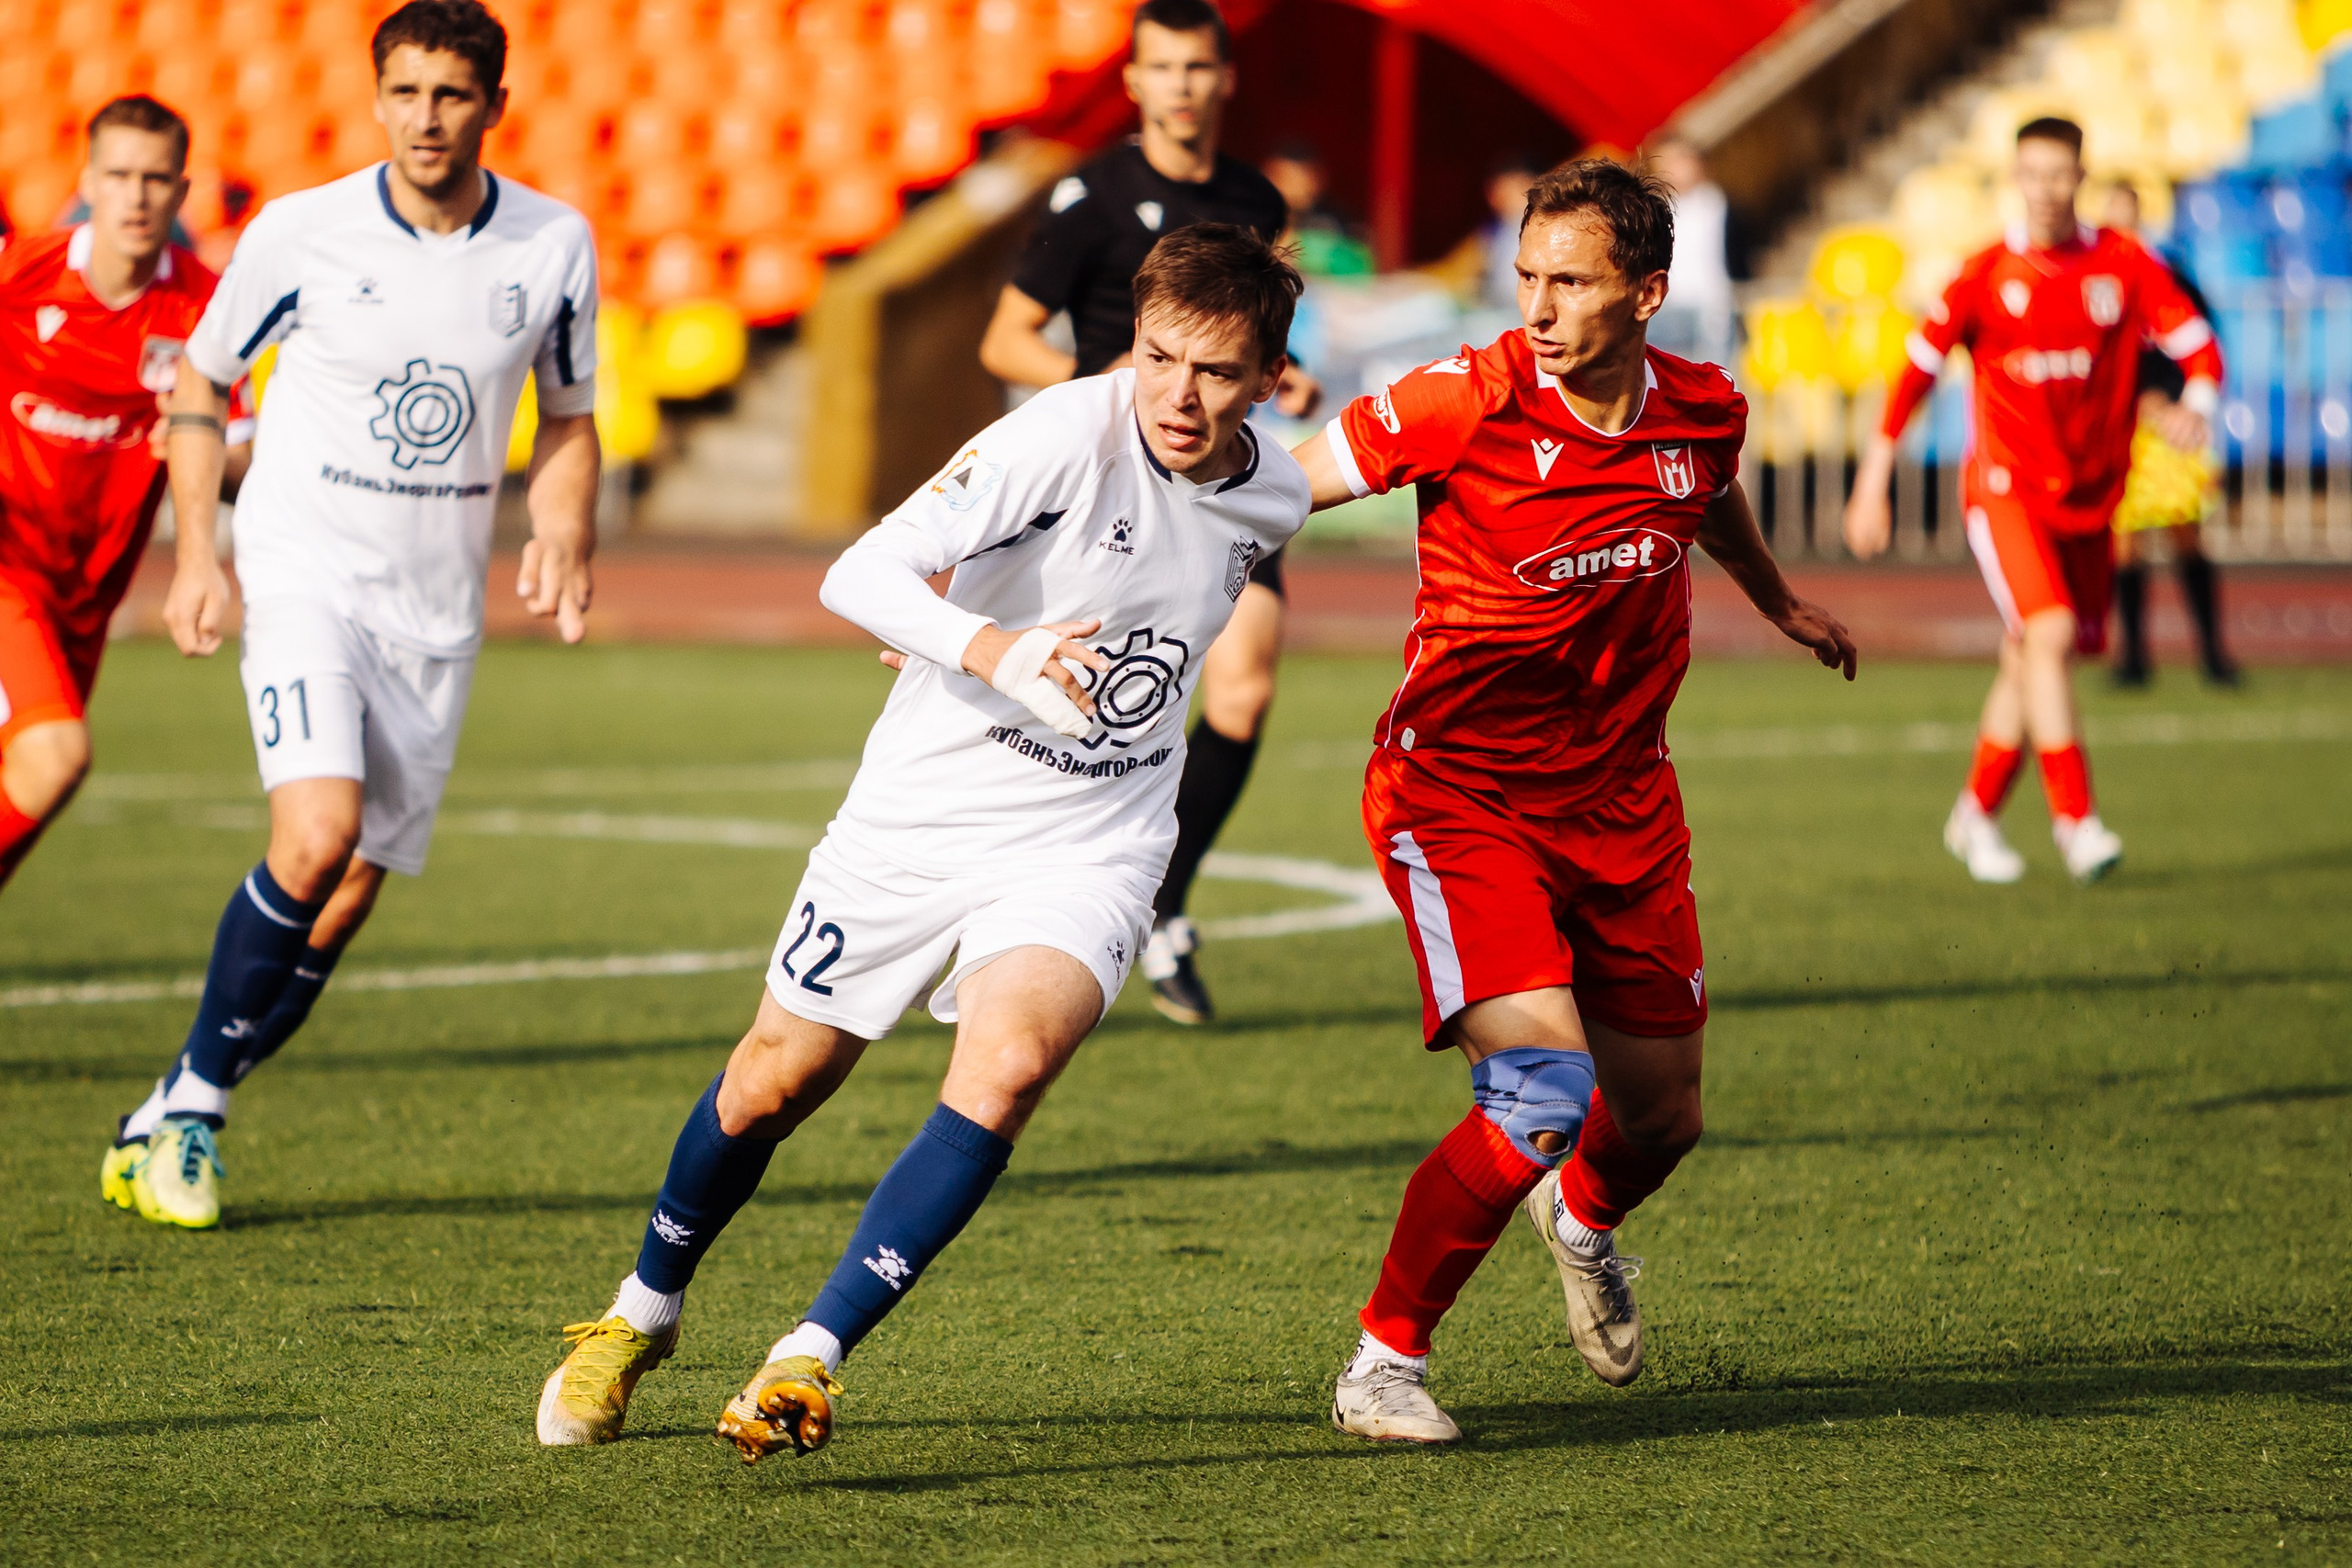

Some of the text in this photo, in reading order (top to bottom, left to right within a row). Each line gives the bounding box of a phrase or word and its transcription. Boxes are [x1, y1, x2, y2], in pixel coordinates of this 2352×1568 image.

[1099, 541, 1135, 556] KELME
[1548, 535, 1655, 581] amet
[260, 678, 311, 748] 31
[781, 900, 844, 997] 22
[862, 1257, 902, 1292] KELME
